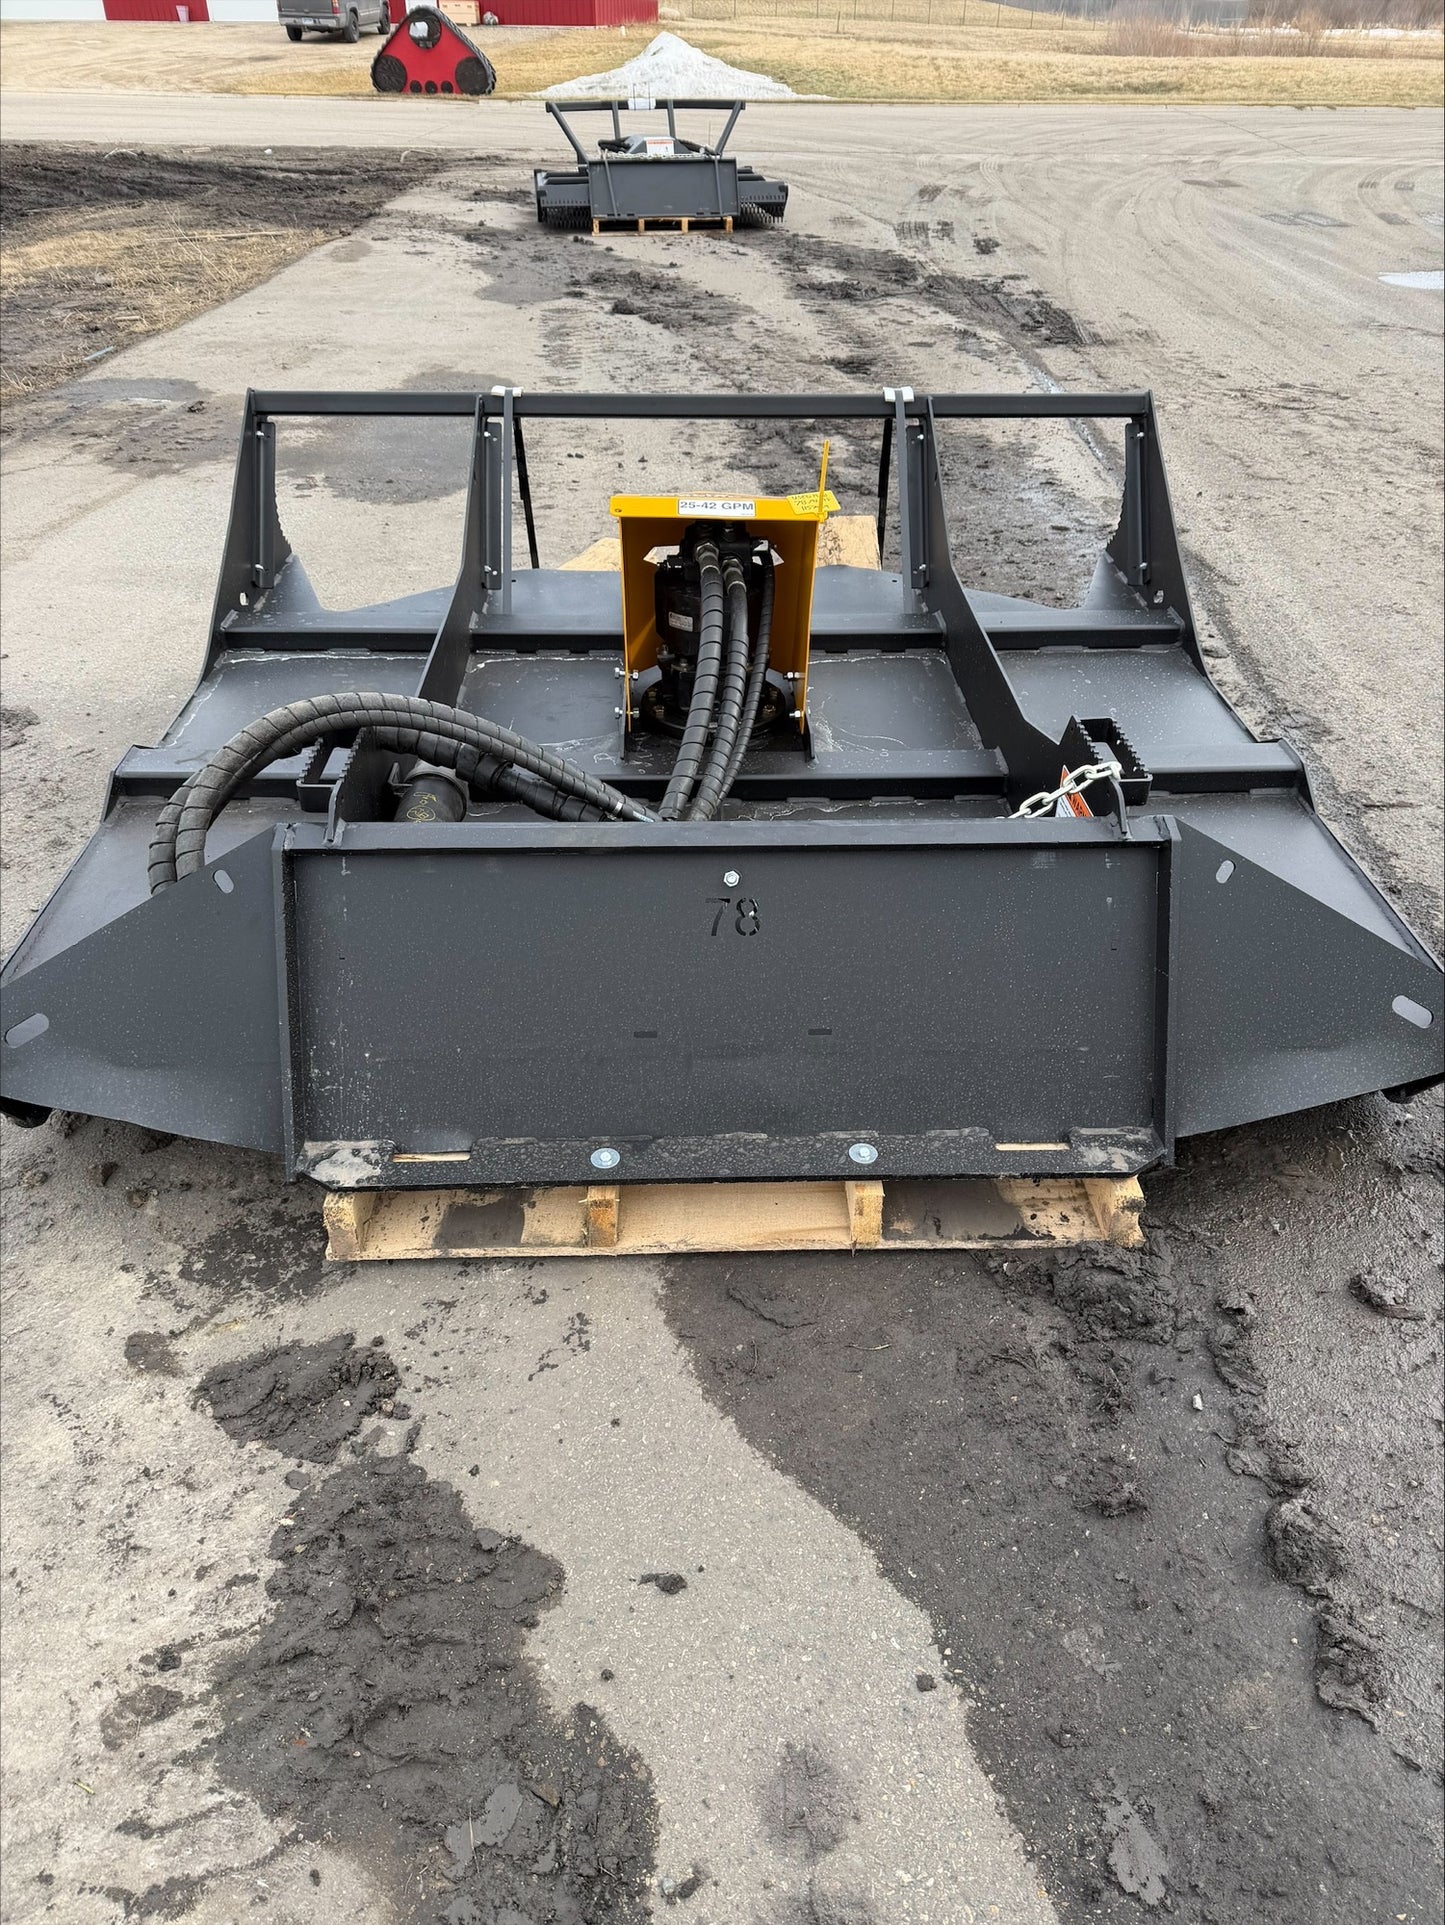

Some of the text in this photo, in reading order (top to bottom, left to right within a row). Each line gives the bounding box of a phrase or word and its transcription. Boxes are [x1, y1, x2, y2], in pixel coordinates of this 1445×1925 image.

[680, 501, 754, 510] 25-42 GPM
[705, 897, 761, 937] 78
